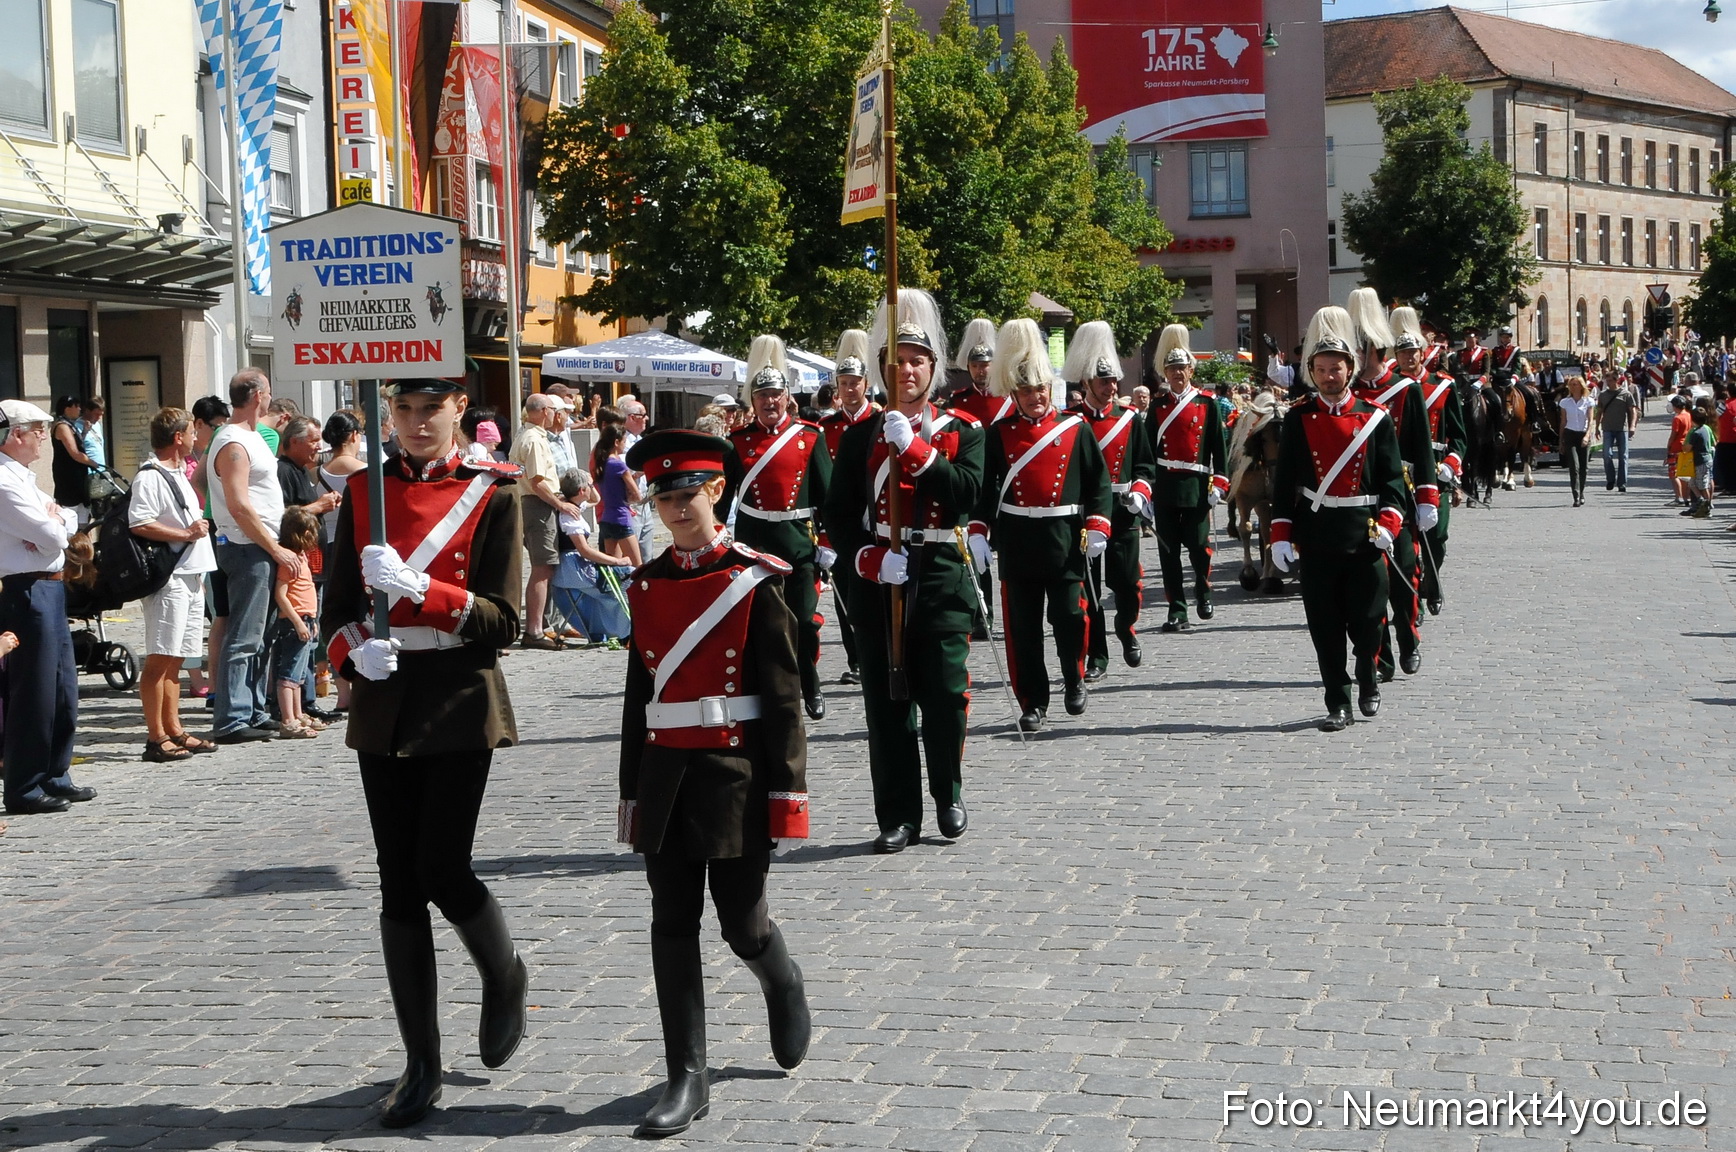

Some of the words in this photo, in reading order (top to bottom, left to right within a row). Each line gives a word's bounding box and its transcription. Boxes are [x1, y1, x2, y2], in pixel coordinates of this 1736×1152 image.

[1141, 27, 1206, 55] 175
[1144, 55, 1206, 72] JAHRE
[1144, 80, 1181, 88] Sparkasse
[1181, 78, 1250, 87] Neumarkt-Parsberg
[341, 182, 372, 200] café
[280, 231, 454, 262] TRADITIONS-
[313, 261, 413, 287] VEREIN
[320, 298, 412, 316] NEUMARKTER
[319, 314, 417, 333] CHEVAULEGERS
[293, 339, 443, 365] ESKADRON
[556, 358, 591, 369] Winkler
[593, 359, 614, 370] Bräu
[651, 360, 688, 372] Winkler
[689, 361, 710, 373] Bräu
